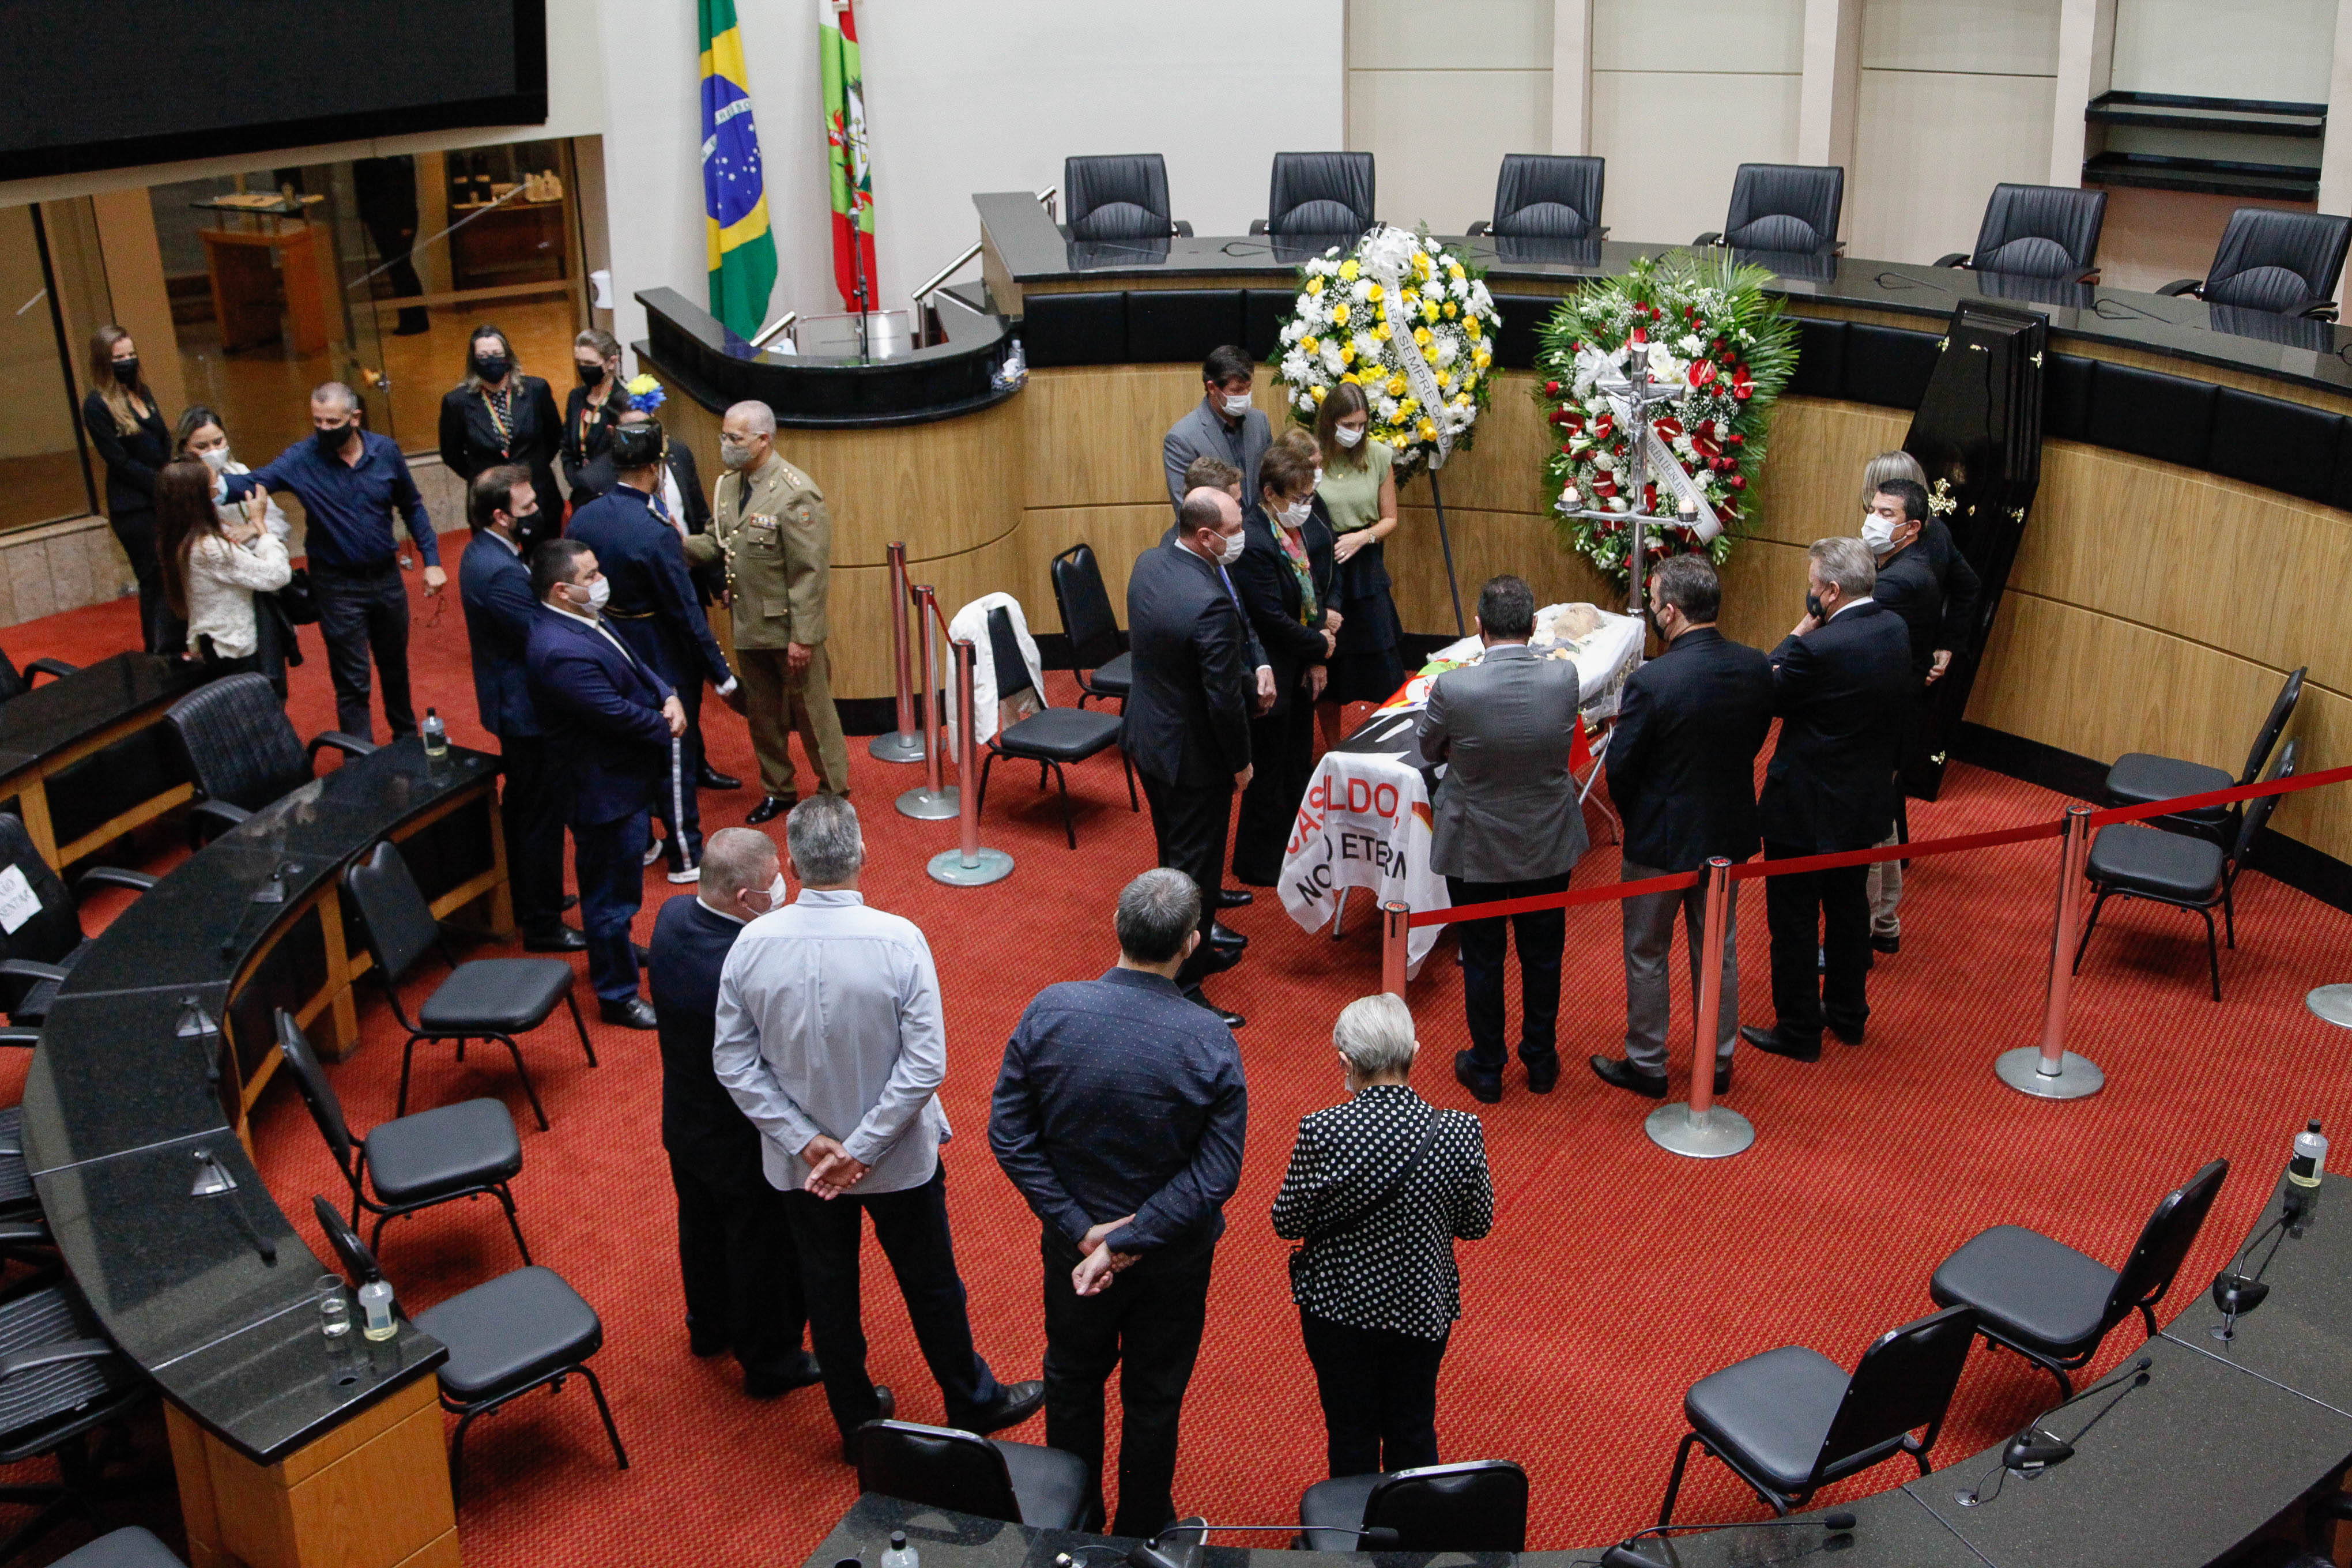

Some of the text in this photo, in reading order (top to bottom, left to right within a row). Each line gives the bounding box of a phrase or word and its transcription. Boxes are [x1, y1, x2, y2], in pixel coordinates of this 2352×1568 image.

[1386, 287, 1400, 332] PARA
[1399, 336, 1436, 402] SEMPRE
[1661, 459, 1688, 497] LEGISLATIV
